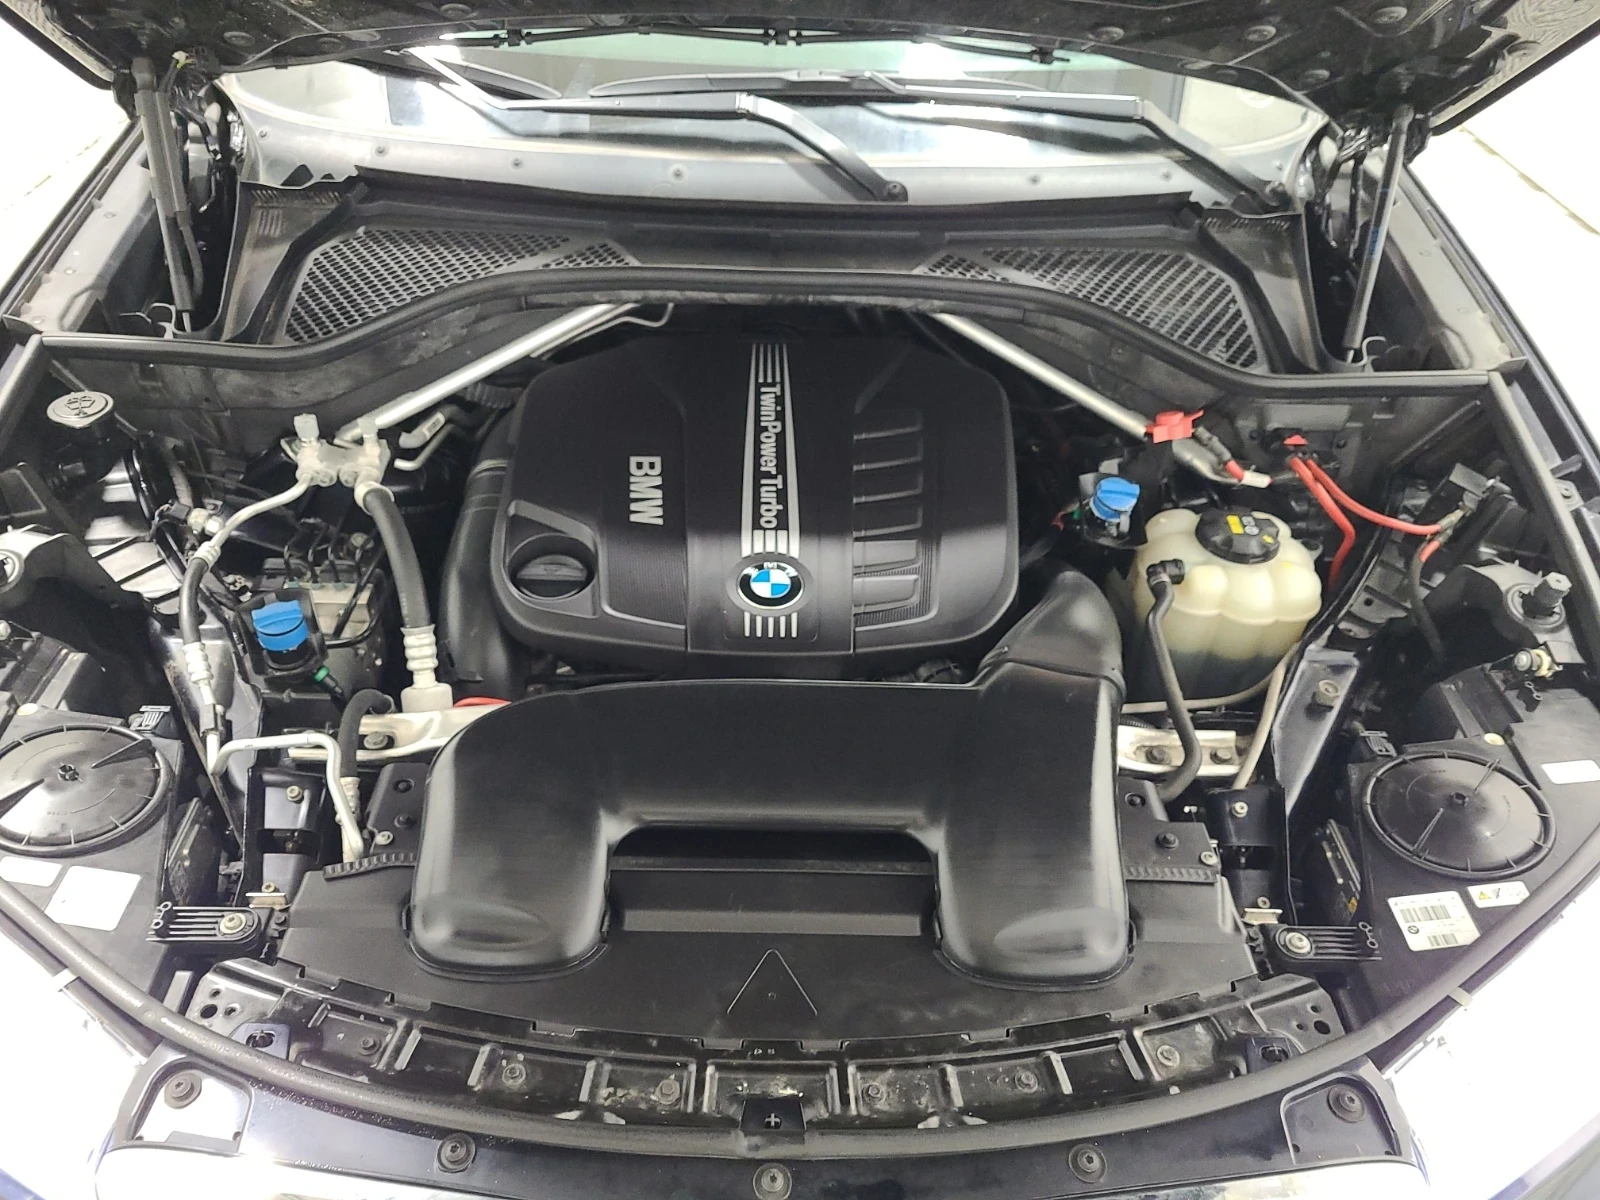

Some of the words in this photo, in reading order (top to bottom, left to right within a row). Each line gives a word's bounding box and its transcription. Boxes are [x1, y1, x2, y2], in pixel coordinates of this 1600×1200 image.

[760, 383, 782, 475] TwinPower
[629, 456, 664, 526] BMW
[760, 475, 783, 529] Turbo
